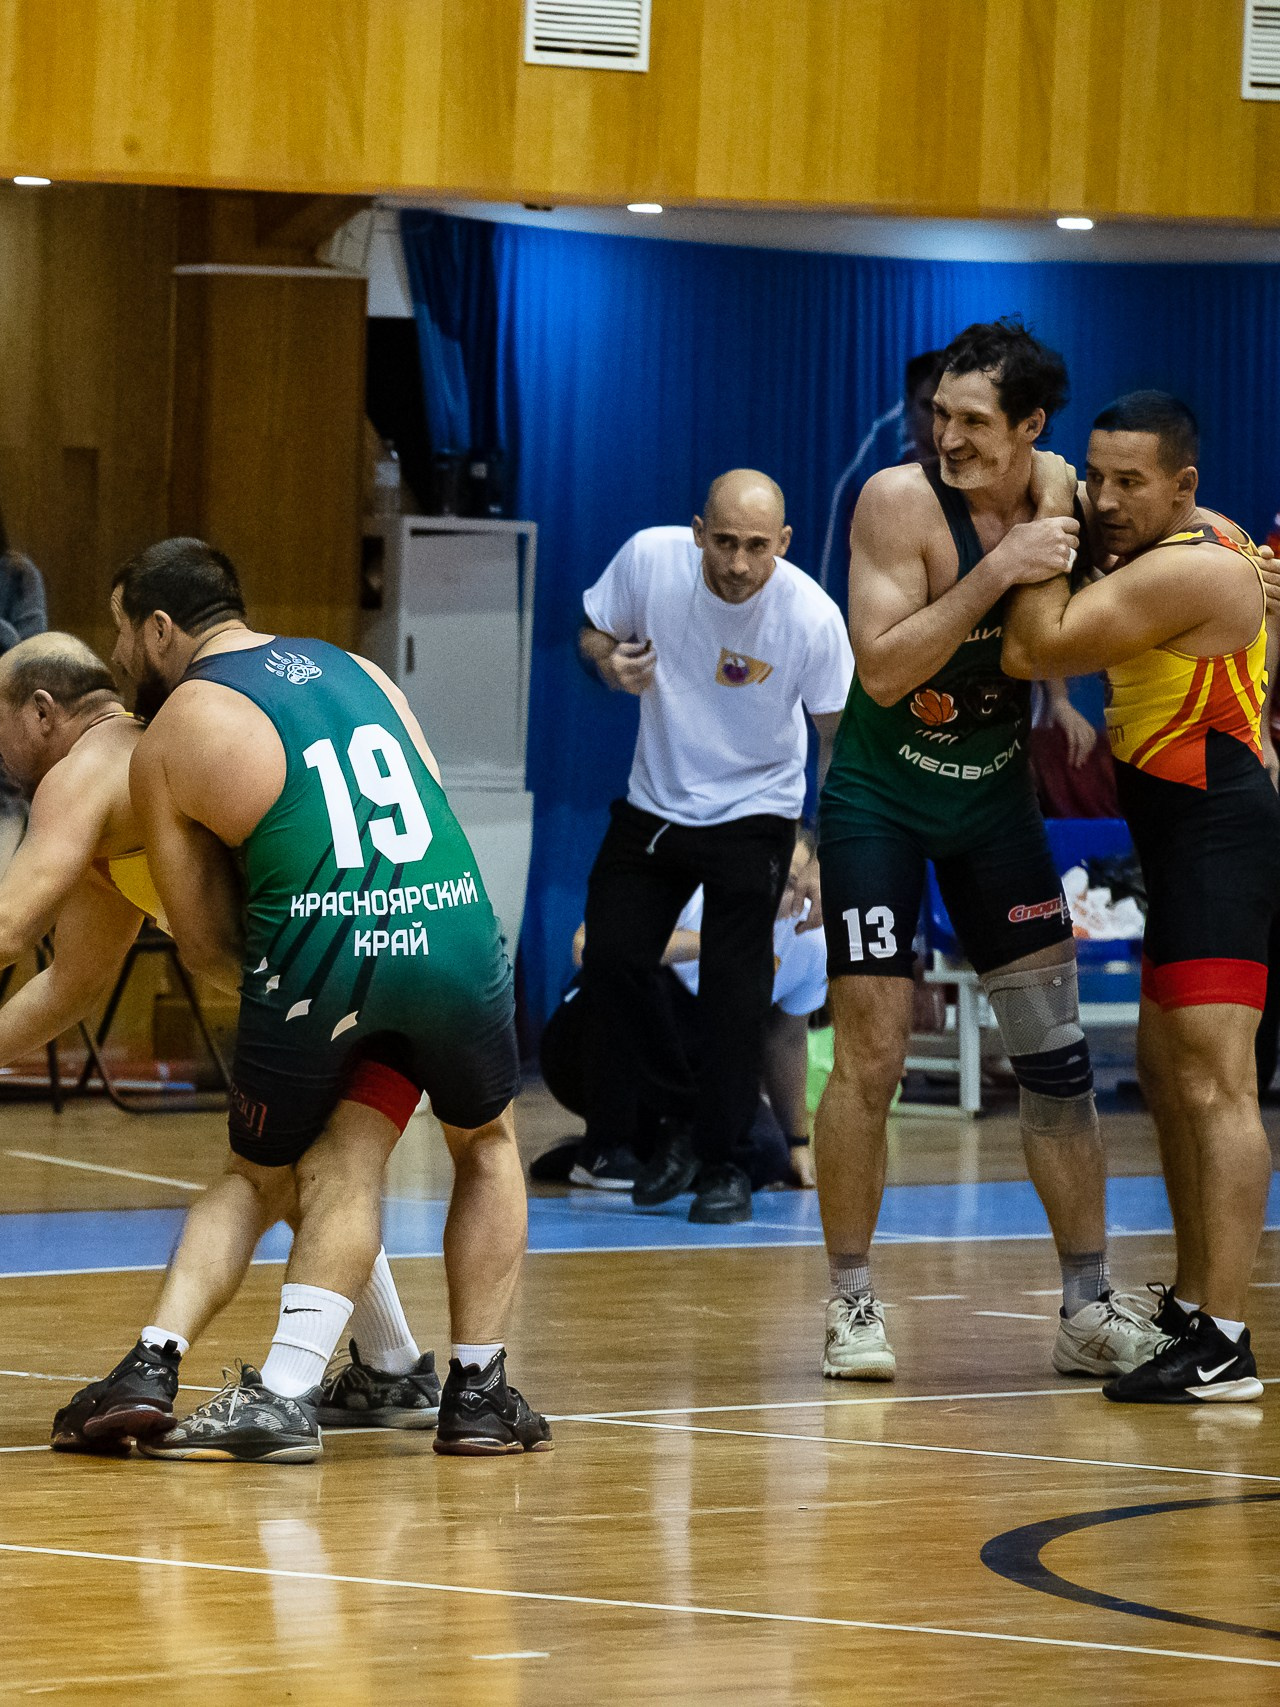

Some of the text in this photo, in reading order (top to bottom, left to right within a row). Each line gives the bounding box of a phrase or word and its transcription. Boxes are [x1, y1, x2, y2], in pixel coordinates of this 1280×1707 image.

[302, 723, 434, 869] 19
[290, 871, 479, 918] КРАСНОЯРСКИЙ
[354, 920, 430, 957] КРАЙ
[842, 905, 898, 962] 13
